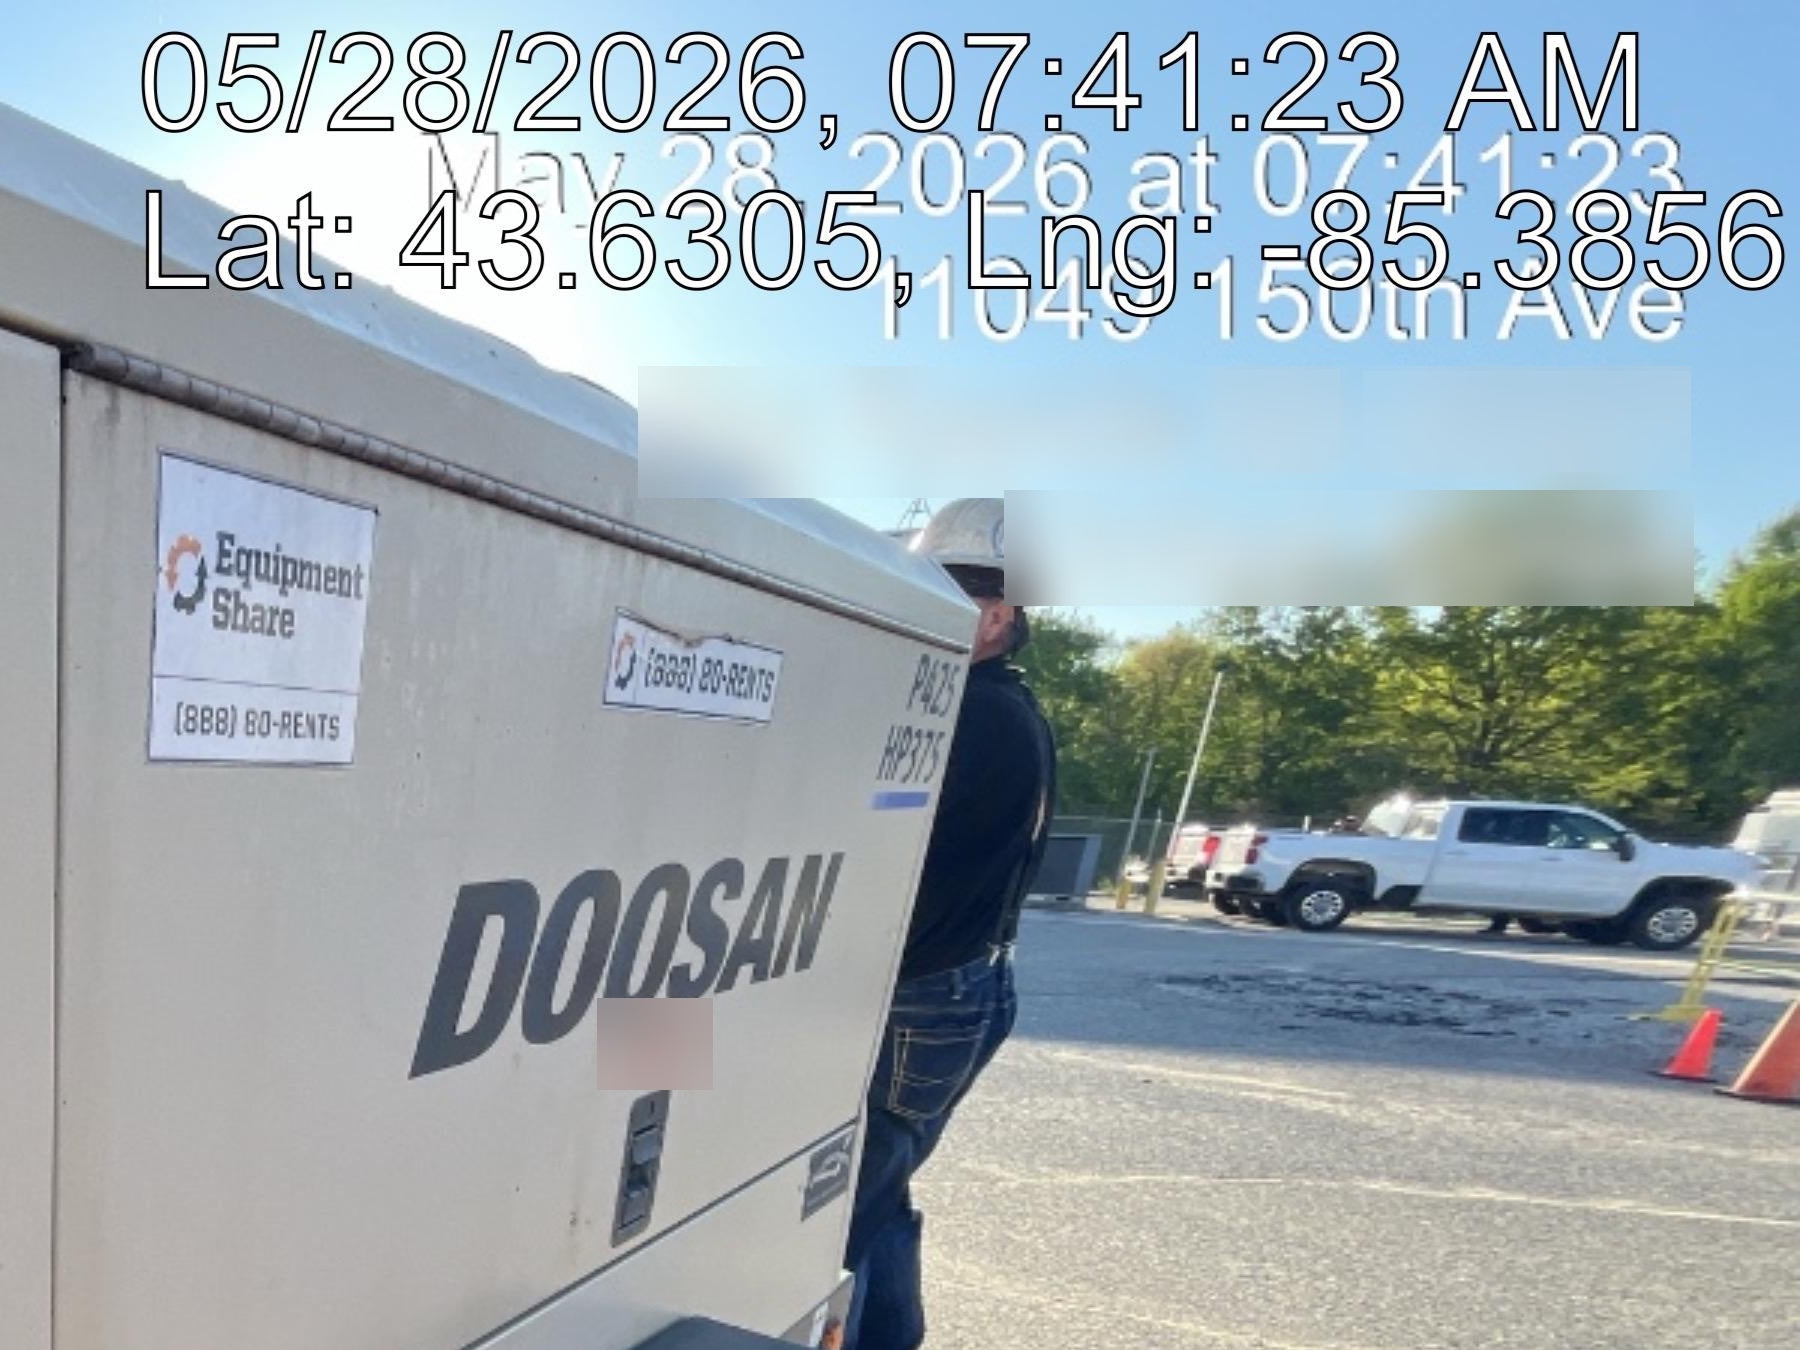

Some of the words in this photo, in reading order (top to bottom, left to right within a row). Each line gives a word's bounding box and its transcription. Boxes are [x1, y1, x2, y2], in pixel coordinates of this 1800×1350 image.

[214, 530, 365, 600] Equipment
[211, 587, 296, 639] Share
[643, 647, 698, 695] (888)
[698, 655, 776, 703] 80-RENTS
[905, 653, 961, 719] P425
[174, 701, 238, 739] (888)
[243, 708, 341, 742] 80-RENTS
[875, 724, 946, 784] HP375
[407, 852, 846, 1080] DOOSAN
